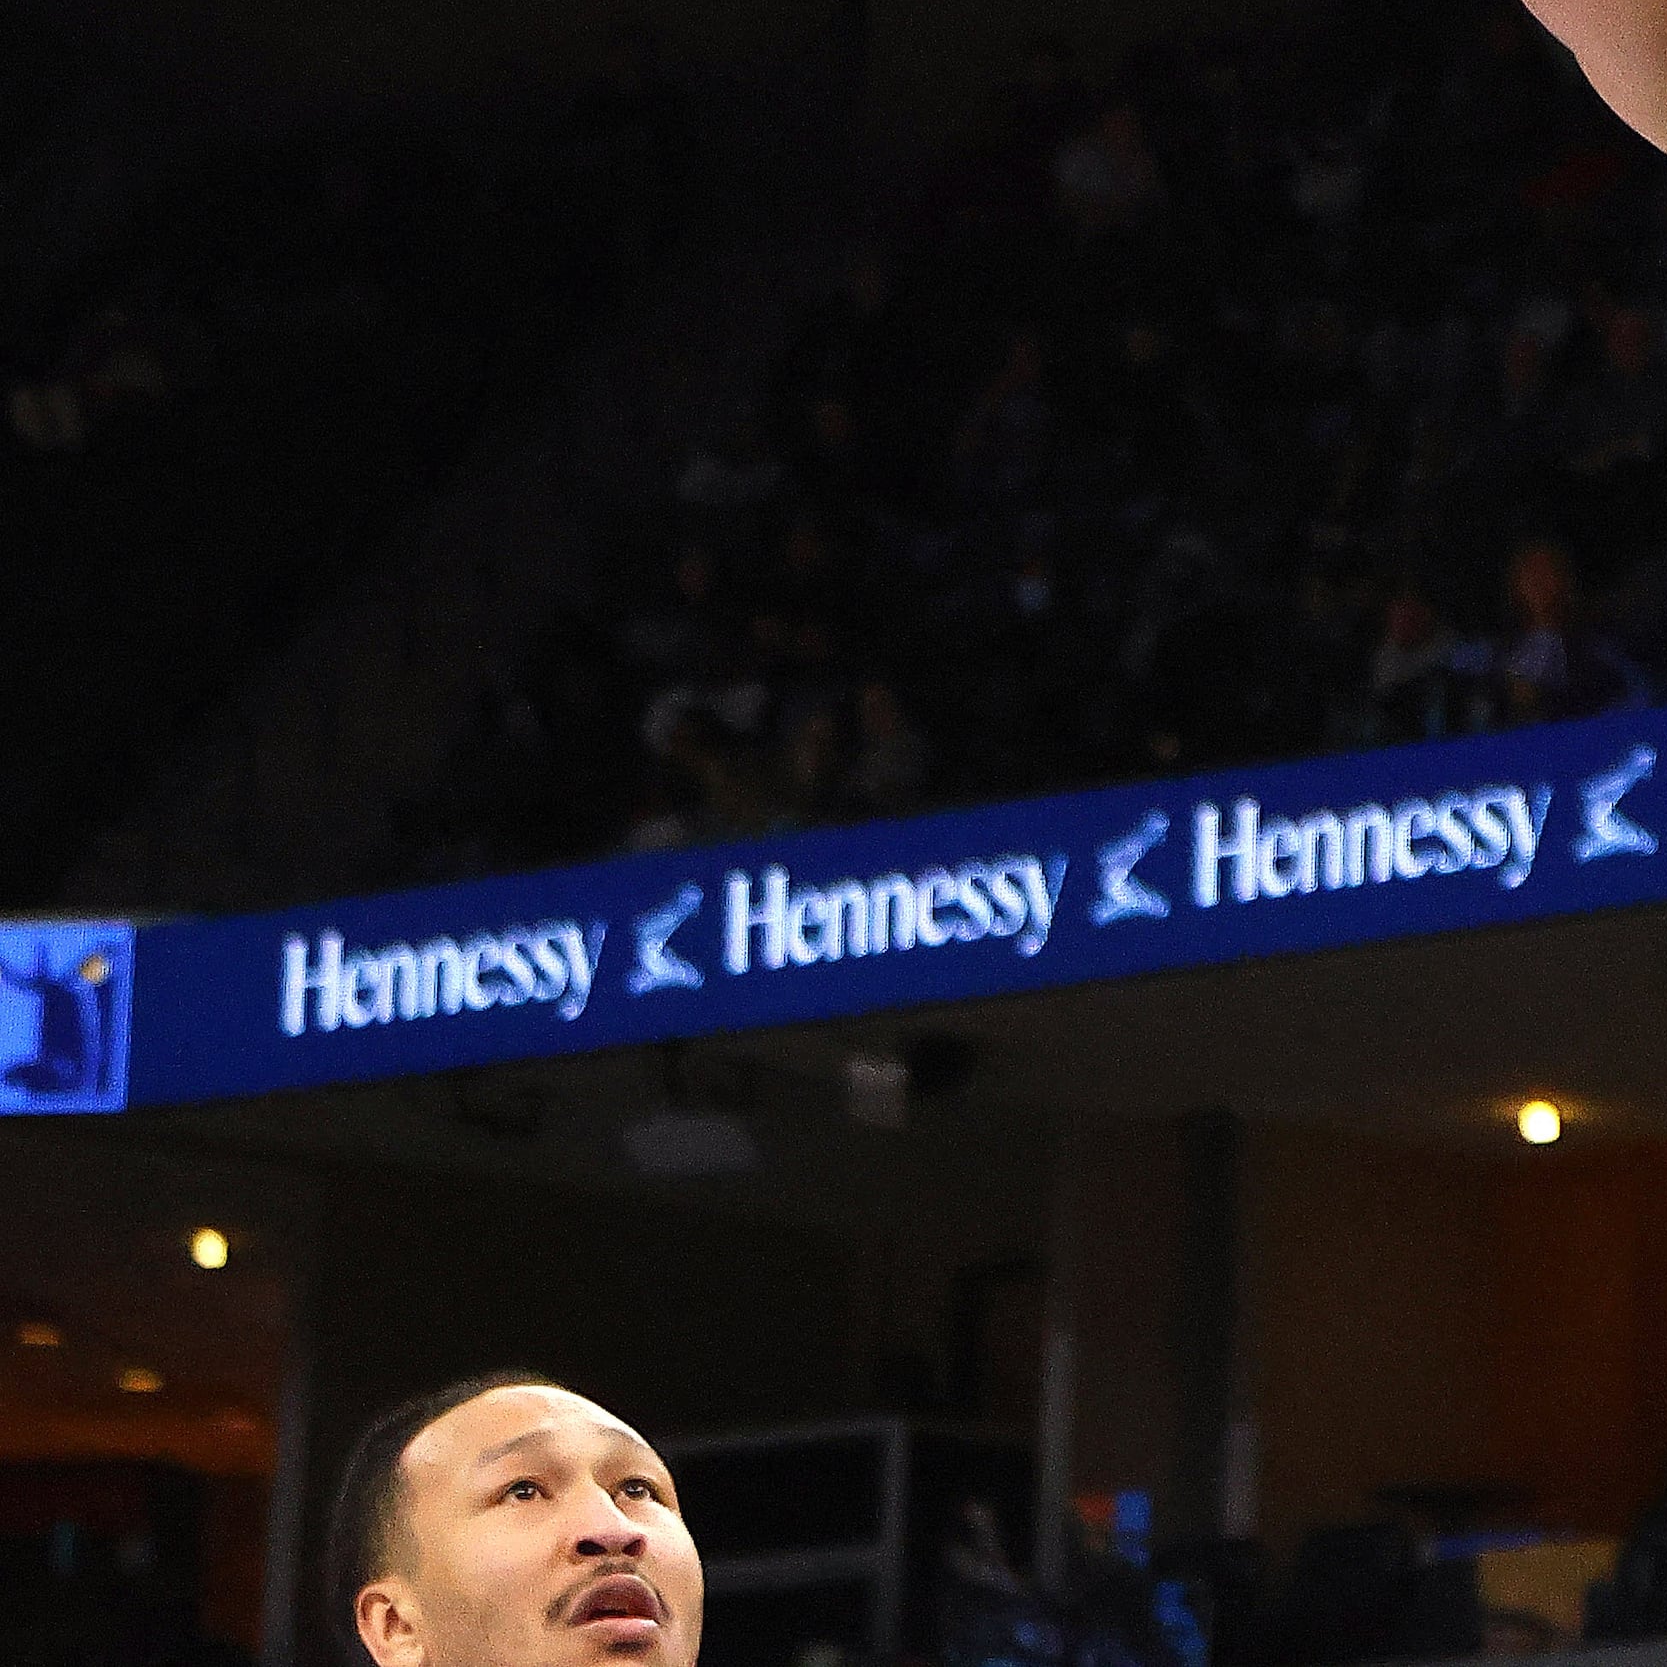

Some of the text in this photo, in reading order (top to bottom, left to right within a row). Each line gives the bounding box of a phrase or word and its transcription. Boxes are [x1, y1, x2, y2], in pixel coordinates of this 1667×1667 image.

[1191, 781, 1554, 910] Hennessy
[719, 850, 1069, 977] Hennessy
[279, 920, 608, 1038] Hennessy
